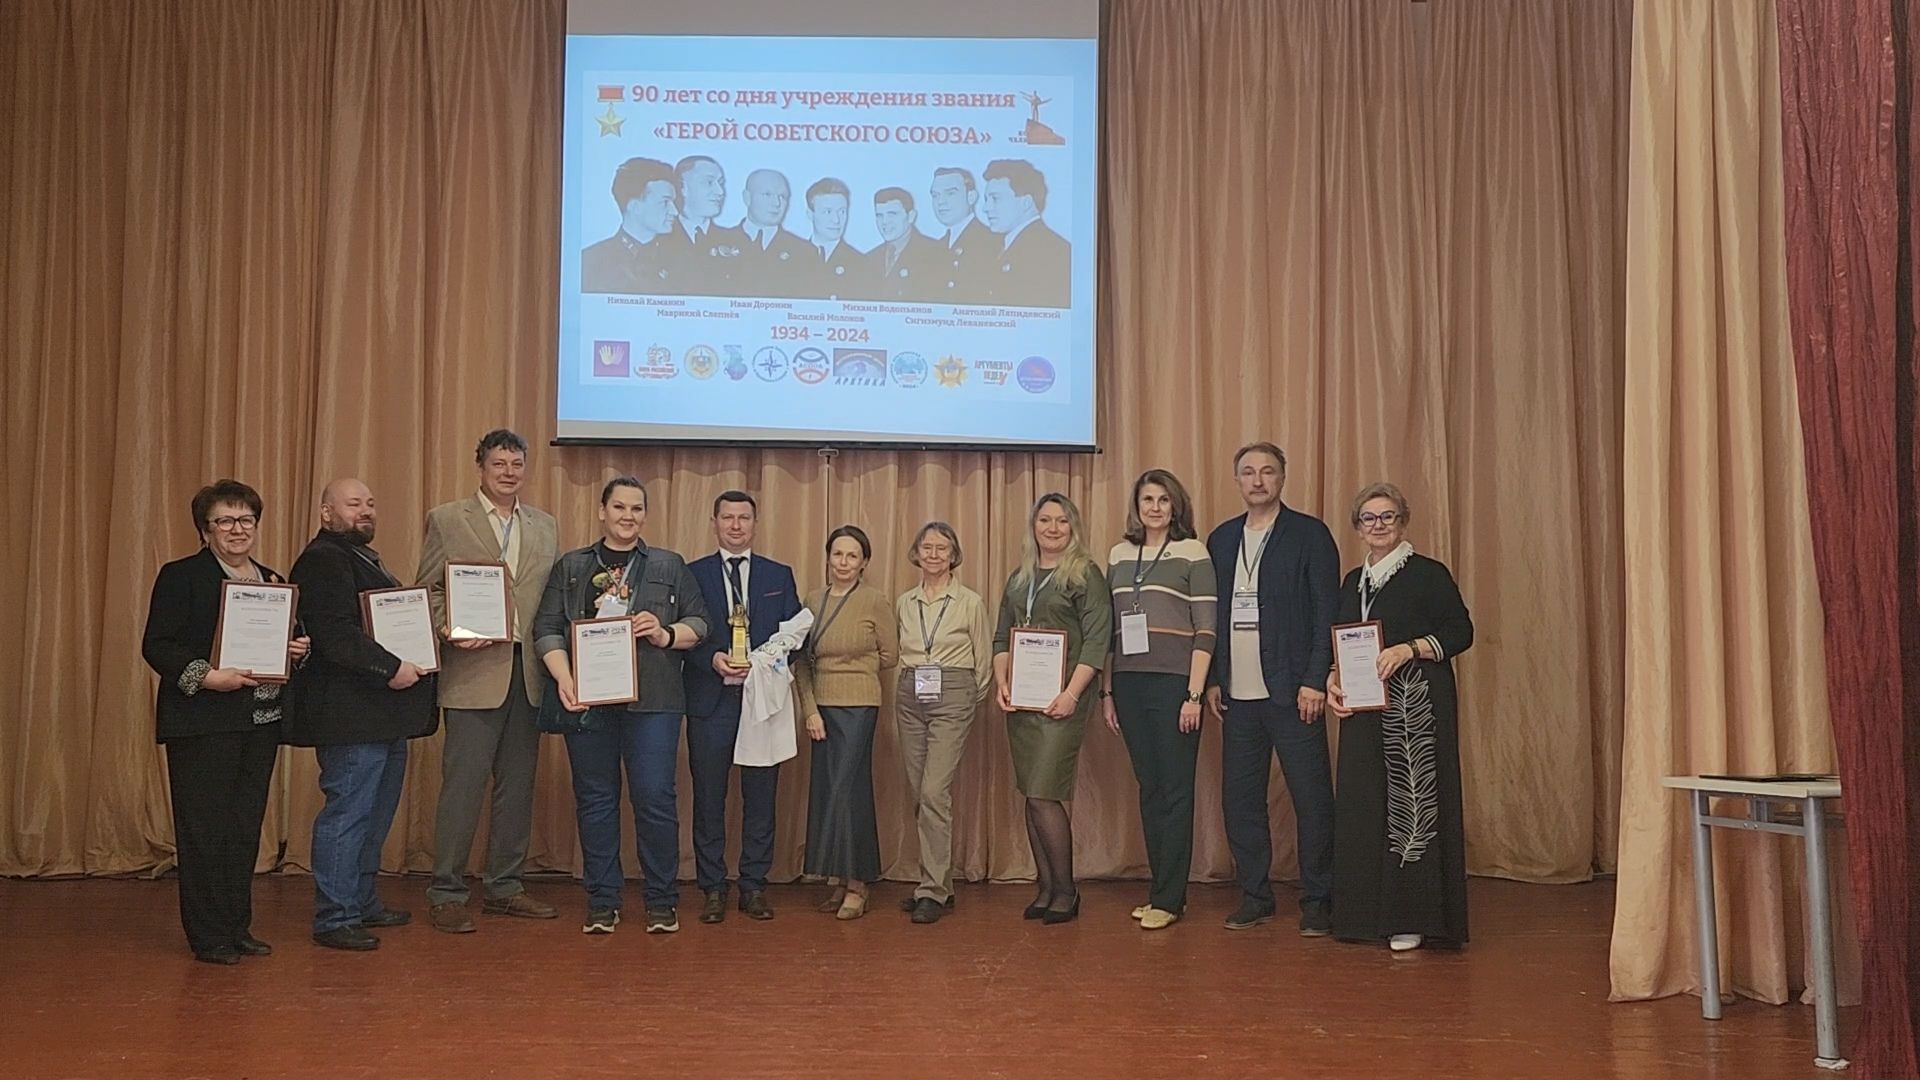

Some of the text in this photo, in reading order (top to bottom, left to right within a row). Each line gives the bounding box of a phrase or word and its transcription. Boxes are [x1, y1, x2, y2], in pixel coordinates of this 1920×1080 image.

[631, 85, 1016, 109] 90 лет со дня учреждения звания
[653, 118, 992, 145] «ГЕРОЙ СОВЕТСКОГО СОЮЗА»
[607, 296, 686, 307] Николай Каманин
[730, 299, 793, 311] Иван Доронин
[656, 308, 740, 320] Маврикий Слепнёв
[842, 303, 933, 315] Михаил Водопьянов
[951, 307, 1062, 320] Анатолий Ляпидевский
[787, 311, 865, 323] Василий Молоков
[904, 316, 1017, 329] Сигизмунд Леваневский
[770, 325, 810, 341] 1934
[826, 327, 870, 343] 2024
[835, 377, 886, 387] АРКТИКА
